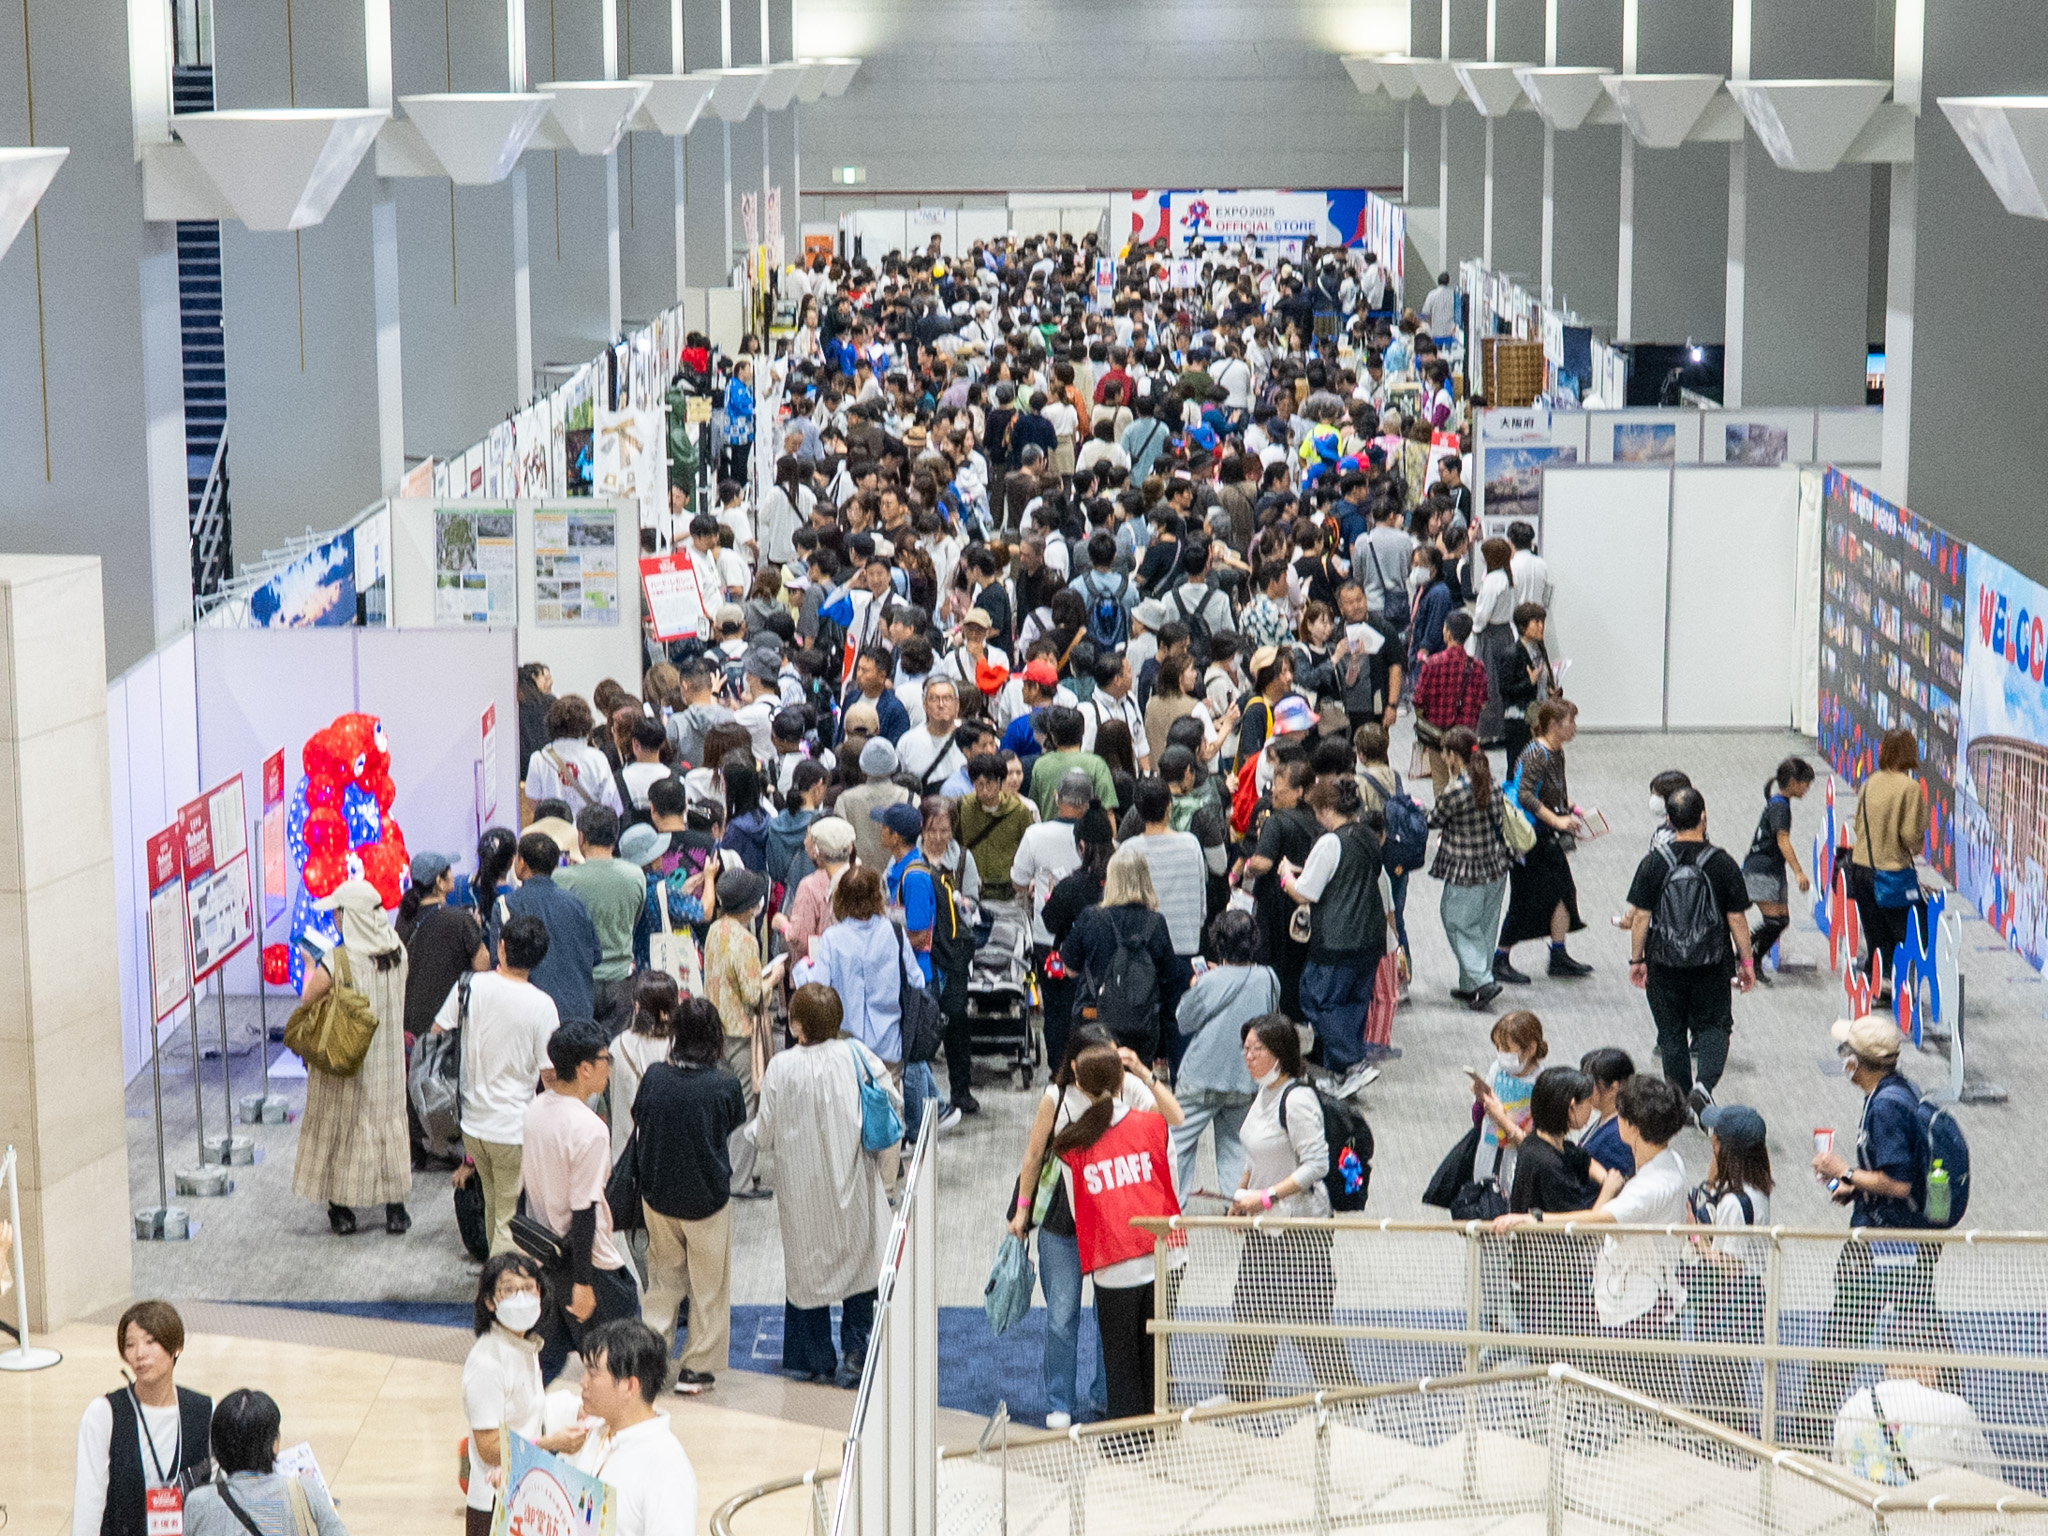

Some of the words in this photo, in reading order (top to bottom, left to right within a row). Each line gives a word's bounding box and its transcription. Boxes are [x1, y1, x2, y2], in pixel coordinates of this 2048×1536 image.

[1216, 206, 1275, 218] EXPO2025
[1216, 220, 1269, 233] OFFICIAL
[1274, 220, 1316, 233] STORE
[1979, 583, 2048, 688] WELCO
[1083, 1151, 1153, 1195] STAFF
